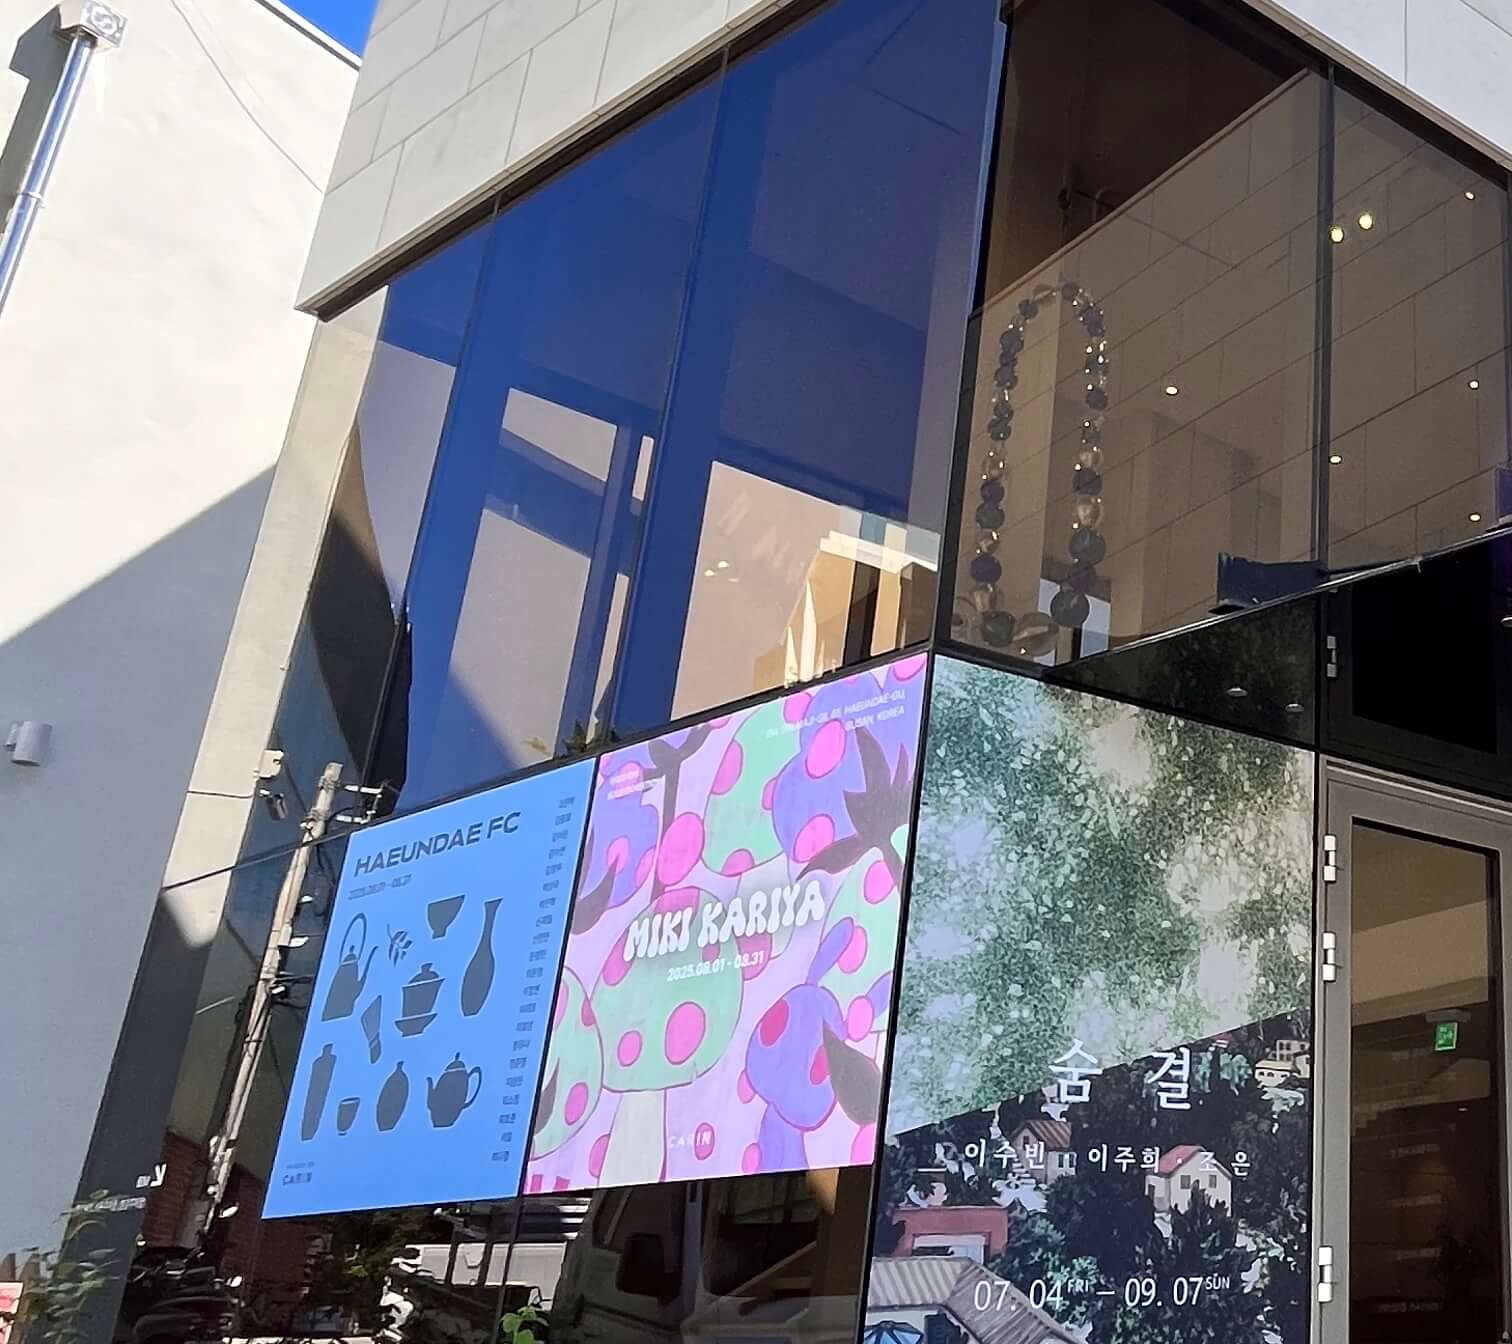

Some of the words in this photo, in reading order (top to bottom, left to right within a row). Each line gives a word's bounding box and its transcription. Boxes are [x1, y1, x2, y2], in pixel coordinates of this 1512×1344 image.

[353, 822, 483, 877] HAEUNDAE
[486, 811, 521, 839] FC
[624, 906, 693, 962] MIKI
[697, 880, 825, 948] KARIYA
[964, 1138, 1046, 1170] 이수빈
[1088, 1143, 1160, 1174] 이주희
